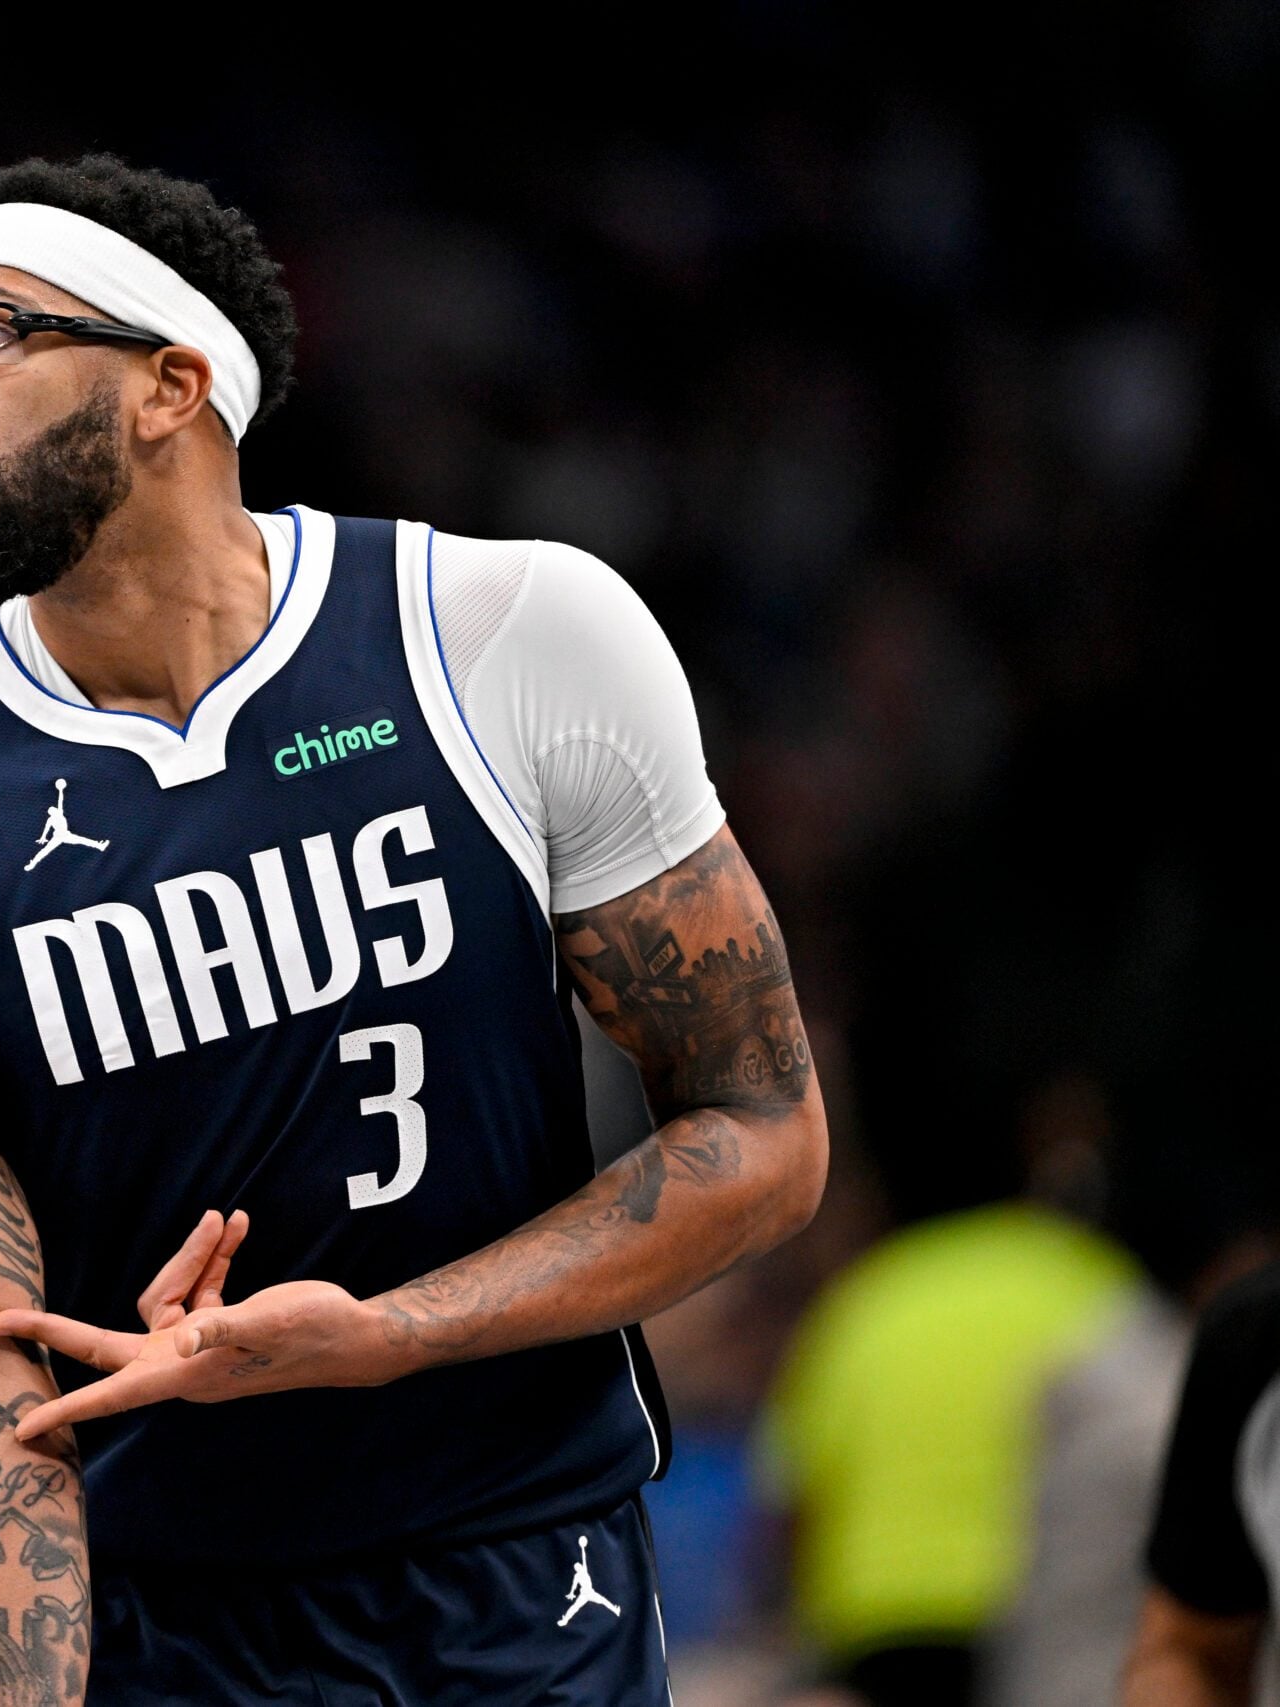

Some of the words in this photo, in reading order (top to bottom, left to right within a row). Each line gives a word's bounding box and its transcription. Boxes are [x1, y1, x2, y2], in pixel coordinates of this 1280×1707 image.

[274, 717, 400, 776] chime
[12, 805, 454, 1086] MAVS
[338, 1023, 428, 1210] 3
